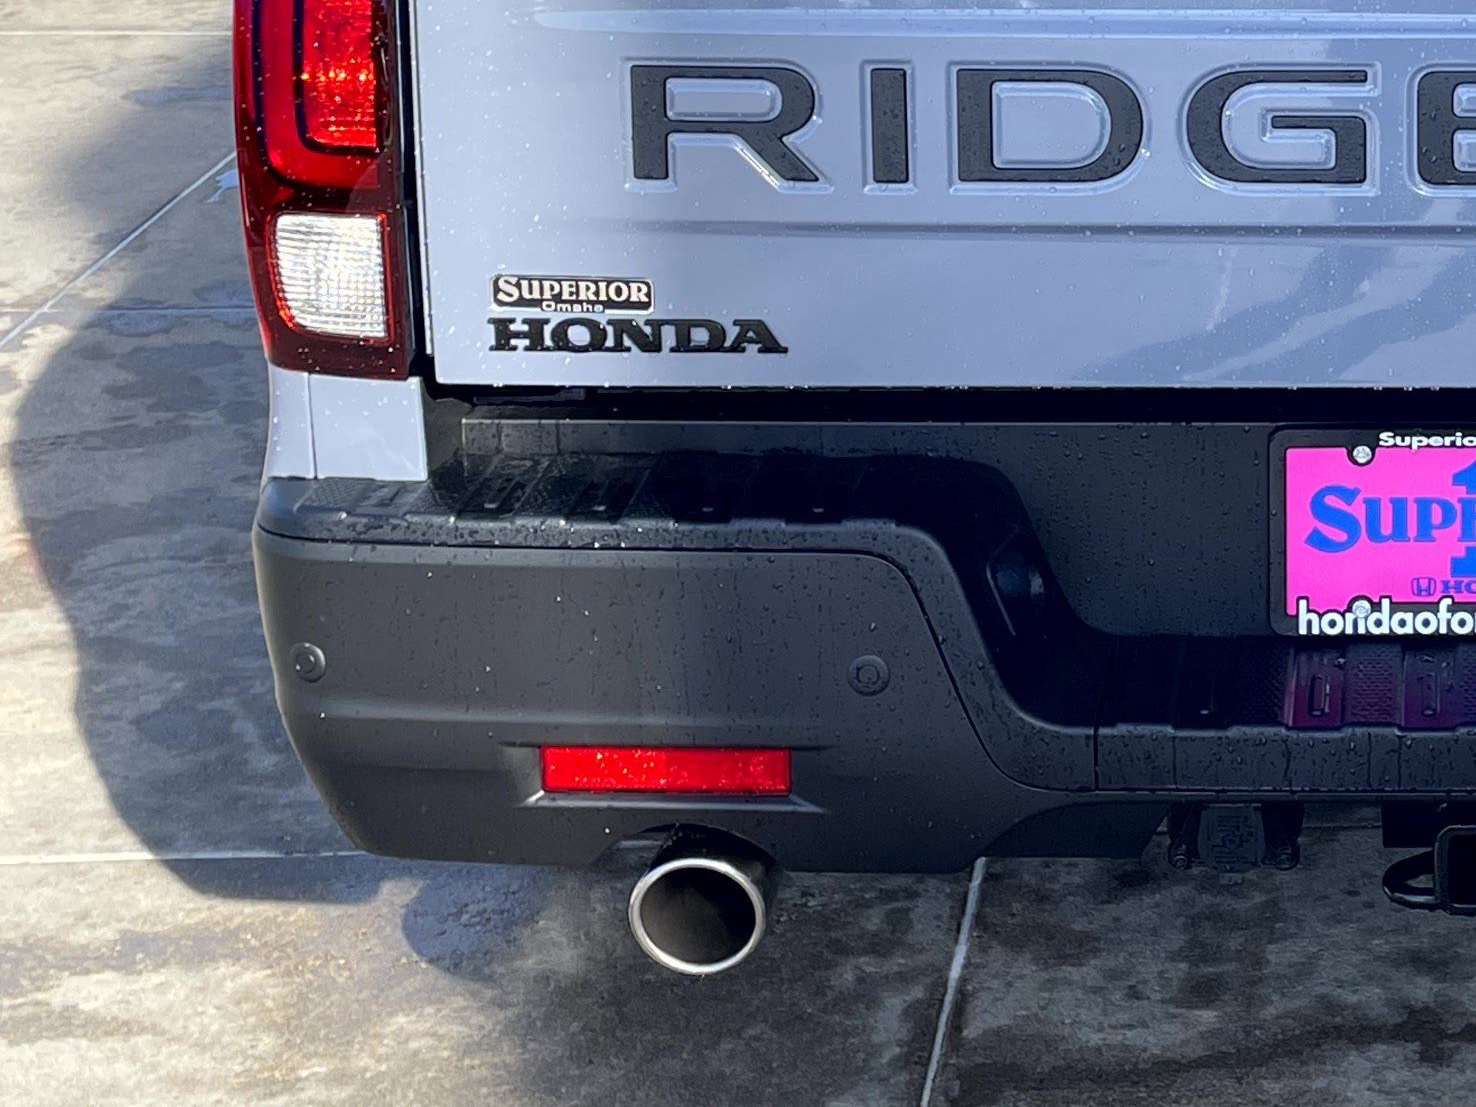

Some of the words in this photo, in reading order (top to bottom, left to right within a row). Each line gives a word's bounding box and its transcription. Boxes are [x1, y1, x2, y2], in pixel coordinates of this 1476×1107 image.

[497, 276, 649, 303] SUPERIOR
[541, 301, 604, 313] Omaha
[487, 317, 789, 354] HONDA
